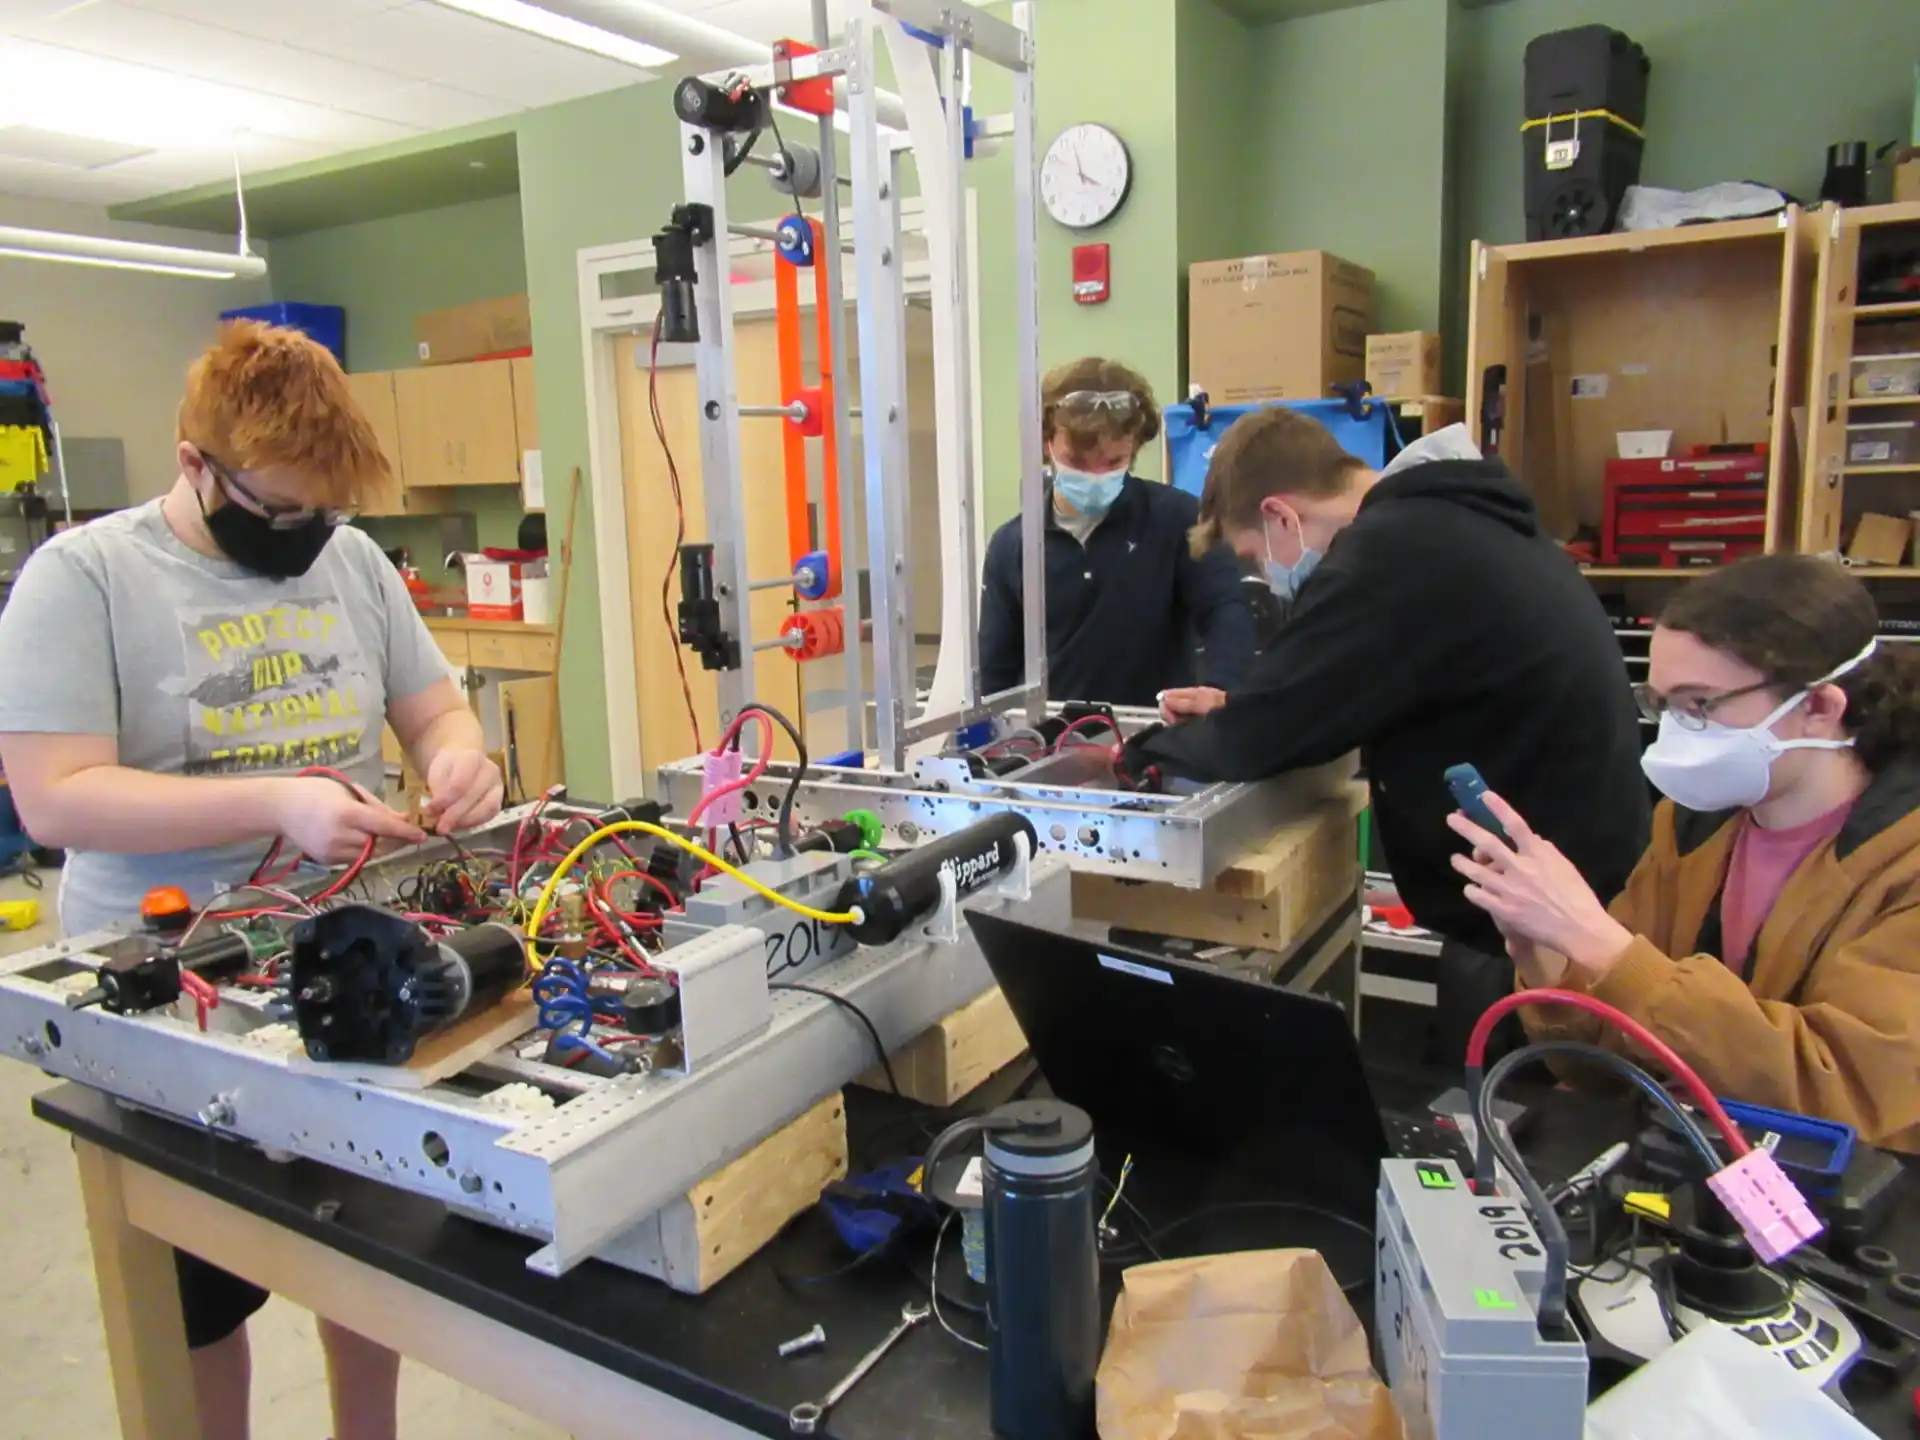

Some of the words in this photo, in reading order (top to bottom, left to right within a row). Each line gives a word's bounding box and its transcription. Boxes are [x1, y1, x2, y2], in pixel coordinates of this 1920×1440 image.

[199, 608, 338, 662] PROTECT
[202, 683, 361, 737] NATIONAL
[1479, 1205, 1541, 1261] 2019
